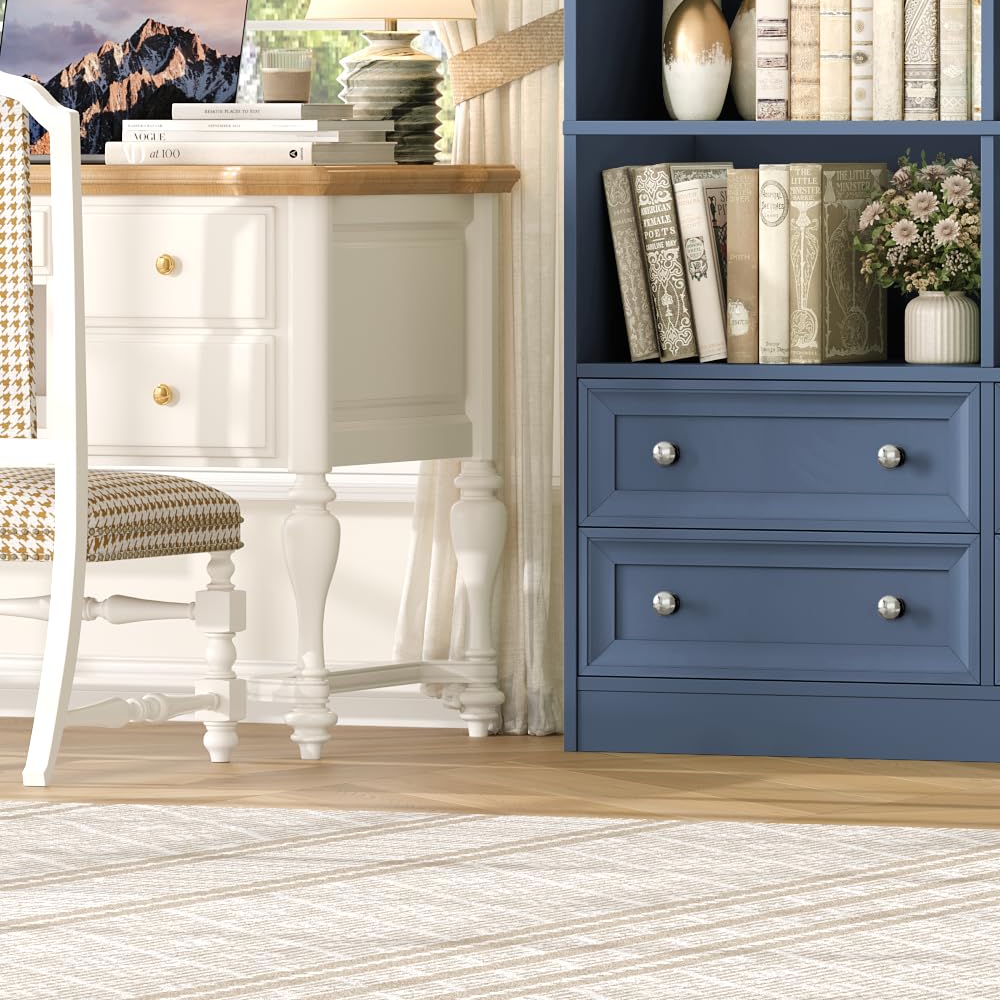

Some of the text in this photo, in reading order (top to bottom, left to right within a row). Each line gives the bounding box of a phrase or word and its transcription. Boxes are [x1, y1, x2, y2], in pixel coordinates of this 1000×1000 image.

[134, 132, 166, 141] VOGUE
[149, 149, 181, 159] at 100
[795, 168, 811, 176] THE
[849, 170, 871, 180] LITTLE
[791, 177, 817, 185] LITTLE
[643, 215, 672, 227] FEMALE
[644, 226, 676, 240] POETS
[665, 240, 677, 248] MAY
